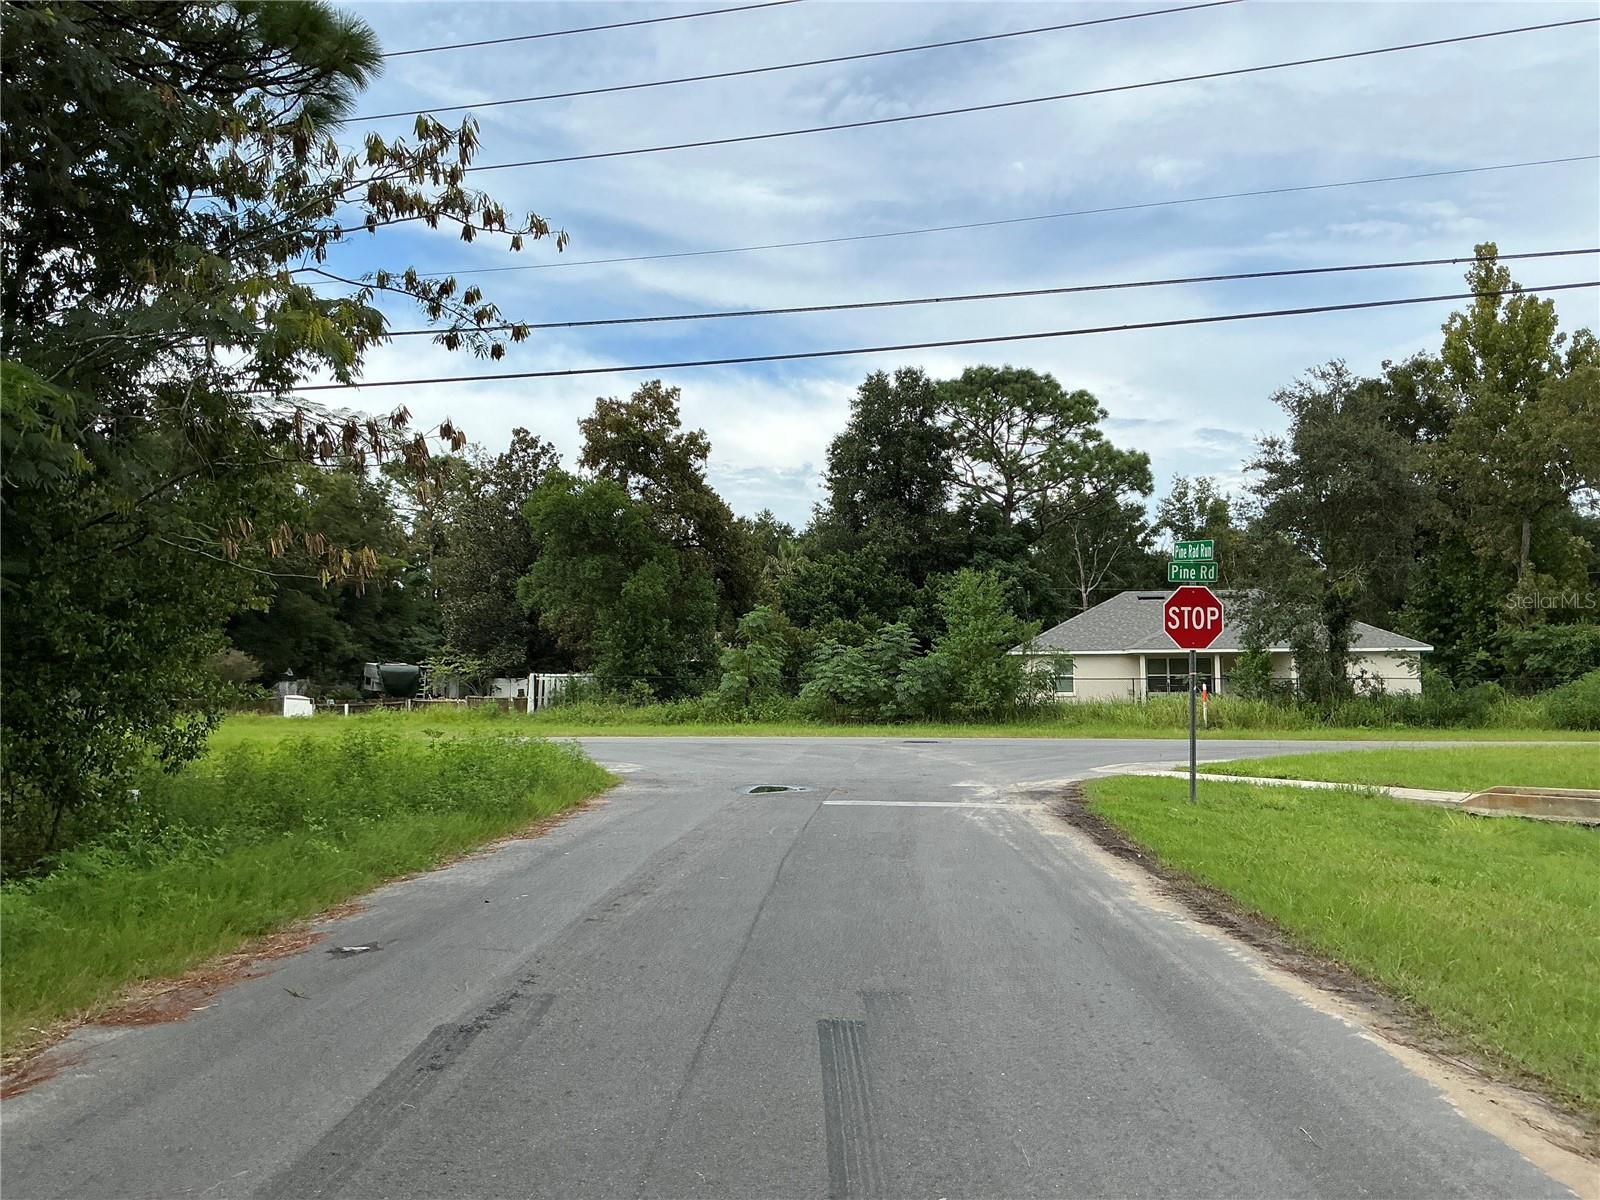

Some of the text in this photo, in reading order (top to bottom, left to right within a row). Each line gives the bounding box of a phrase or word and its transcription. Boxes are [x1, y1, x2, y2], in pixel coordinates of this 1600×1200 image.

[1174, 545, 1187, 559] Pine
[1200, 543, 1212, 558] Run
[1171, 565, 1215, 579] Pine Rd
[1168, 606, 1219, 630] STOP
